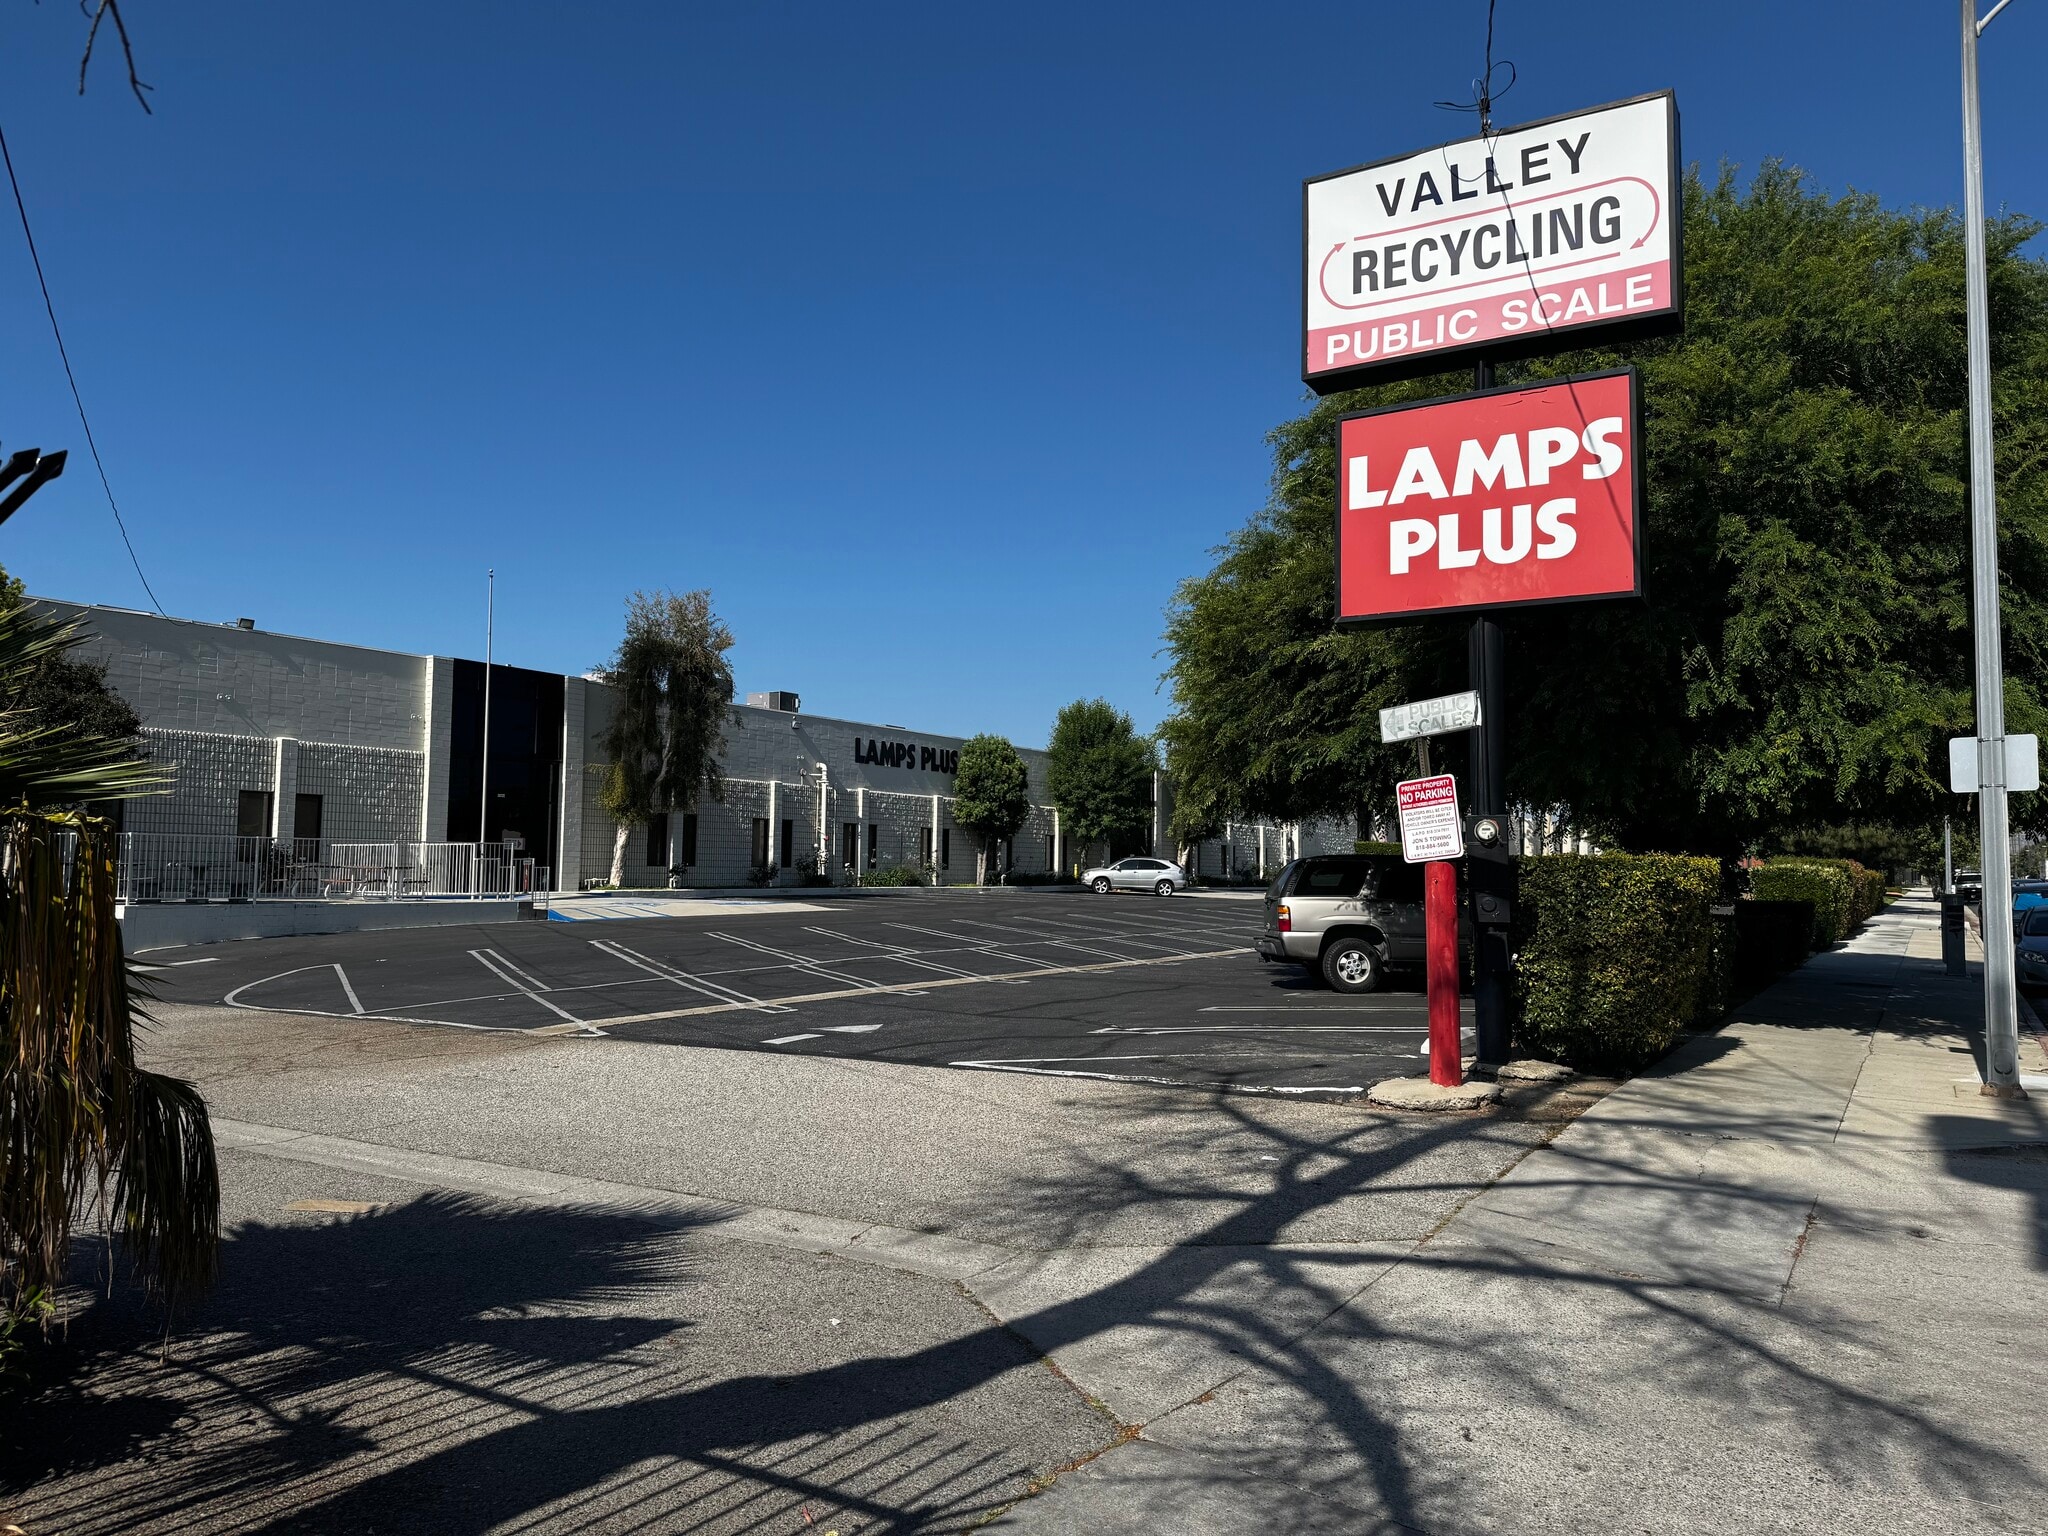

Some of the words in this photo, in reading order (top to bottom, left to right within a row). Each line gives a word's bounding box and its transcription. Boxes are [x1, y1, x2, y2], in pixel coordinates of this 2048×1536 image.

[1376, 132, 1591, 217] VALLEY
[1352, 195, 1621, 295] RECYCLING
[1326, 309, 1478, 365] PUBLIC
[1501, 273, 1654, 332] SCALE
[1348, 416, 1623, 510] LAMPS
[1389, 497, 1577, 575] PLUS
[1409, 696, 1468, 719] PUBLIC
[855, 737, 916, 770] LAMPS
[921, 746, 958, 775] PLUS
[1400, 793, 1413, 803] NO
[1414, 787, 1453, 801] PARKING
[1401, 784, 1421, 792] PRIVATE
[1422, 779, 1450, 789] PROPERTY
[1429, 834, 1452, 842] TOWING
